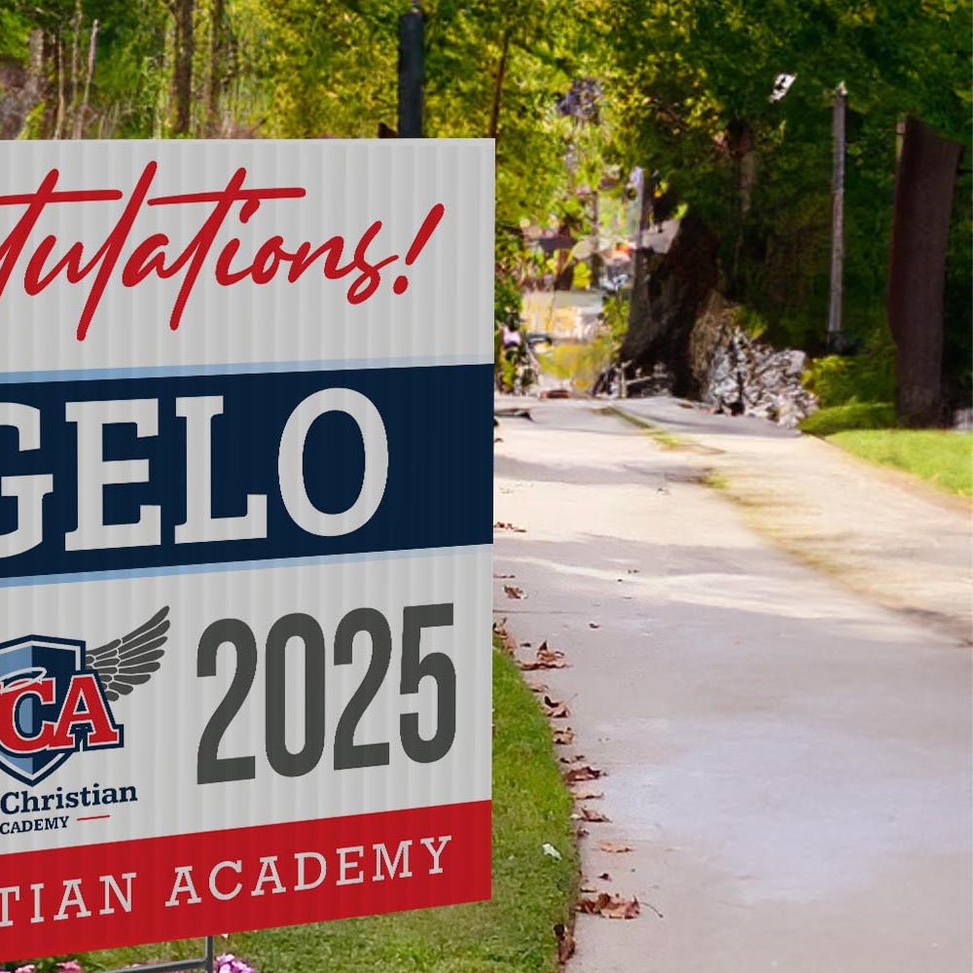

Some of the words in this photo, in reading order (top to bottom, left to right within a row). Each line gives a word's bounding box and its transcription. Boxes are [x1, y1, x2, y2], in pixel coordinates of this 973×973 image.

[197, 604, 457, 787] 2025
[0, 783, 138, 813] Christian
[165, 836, 453, 907] ACADEMY
